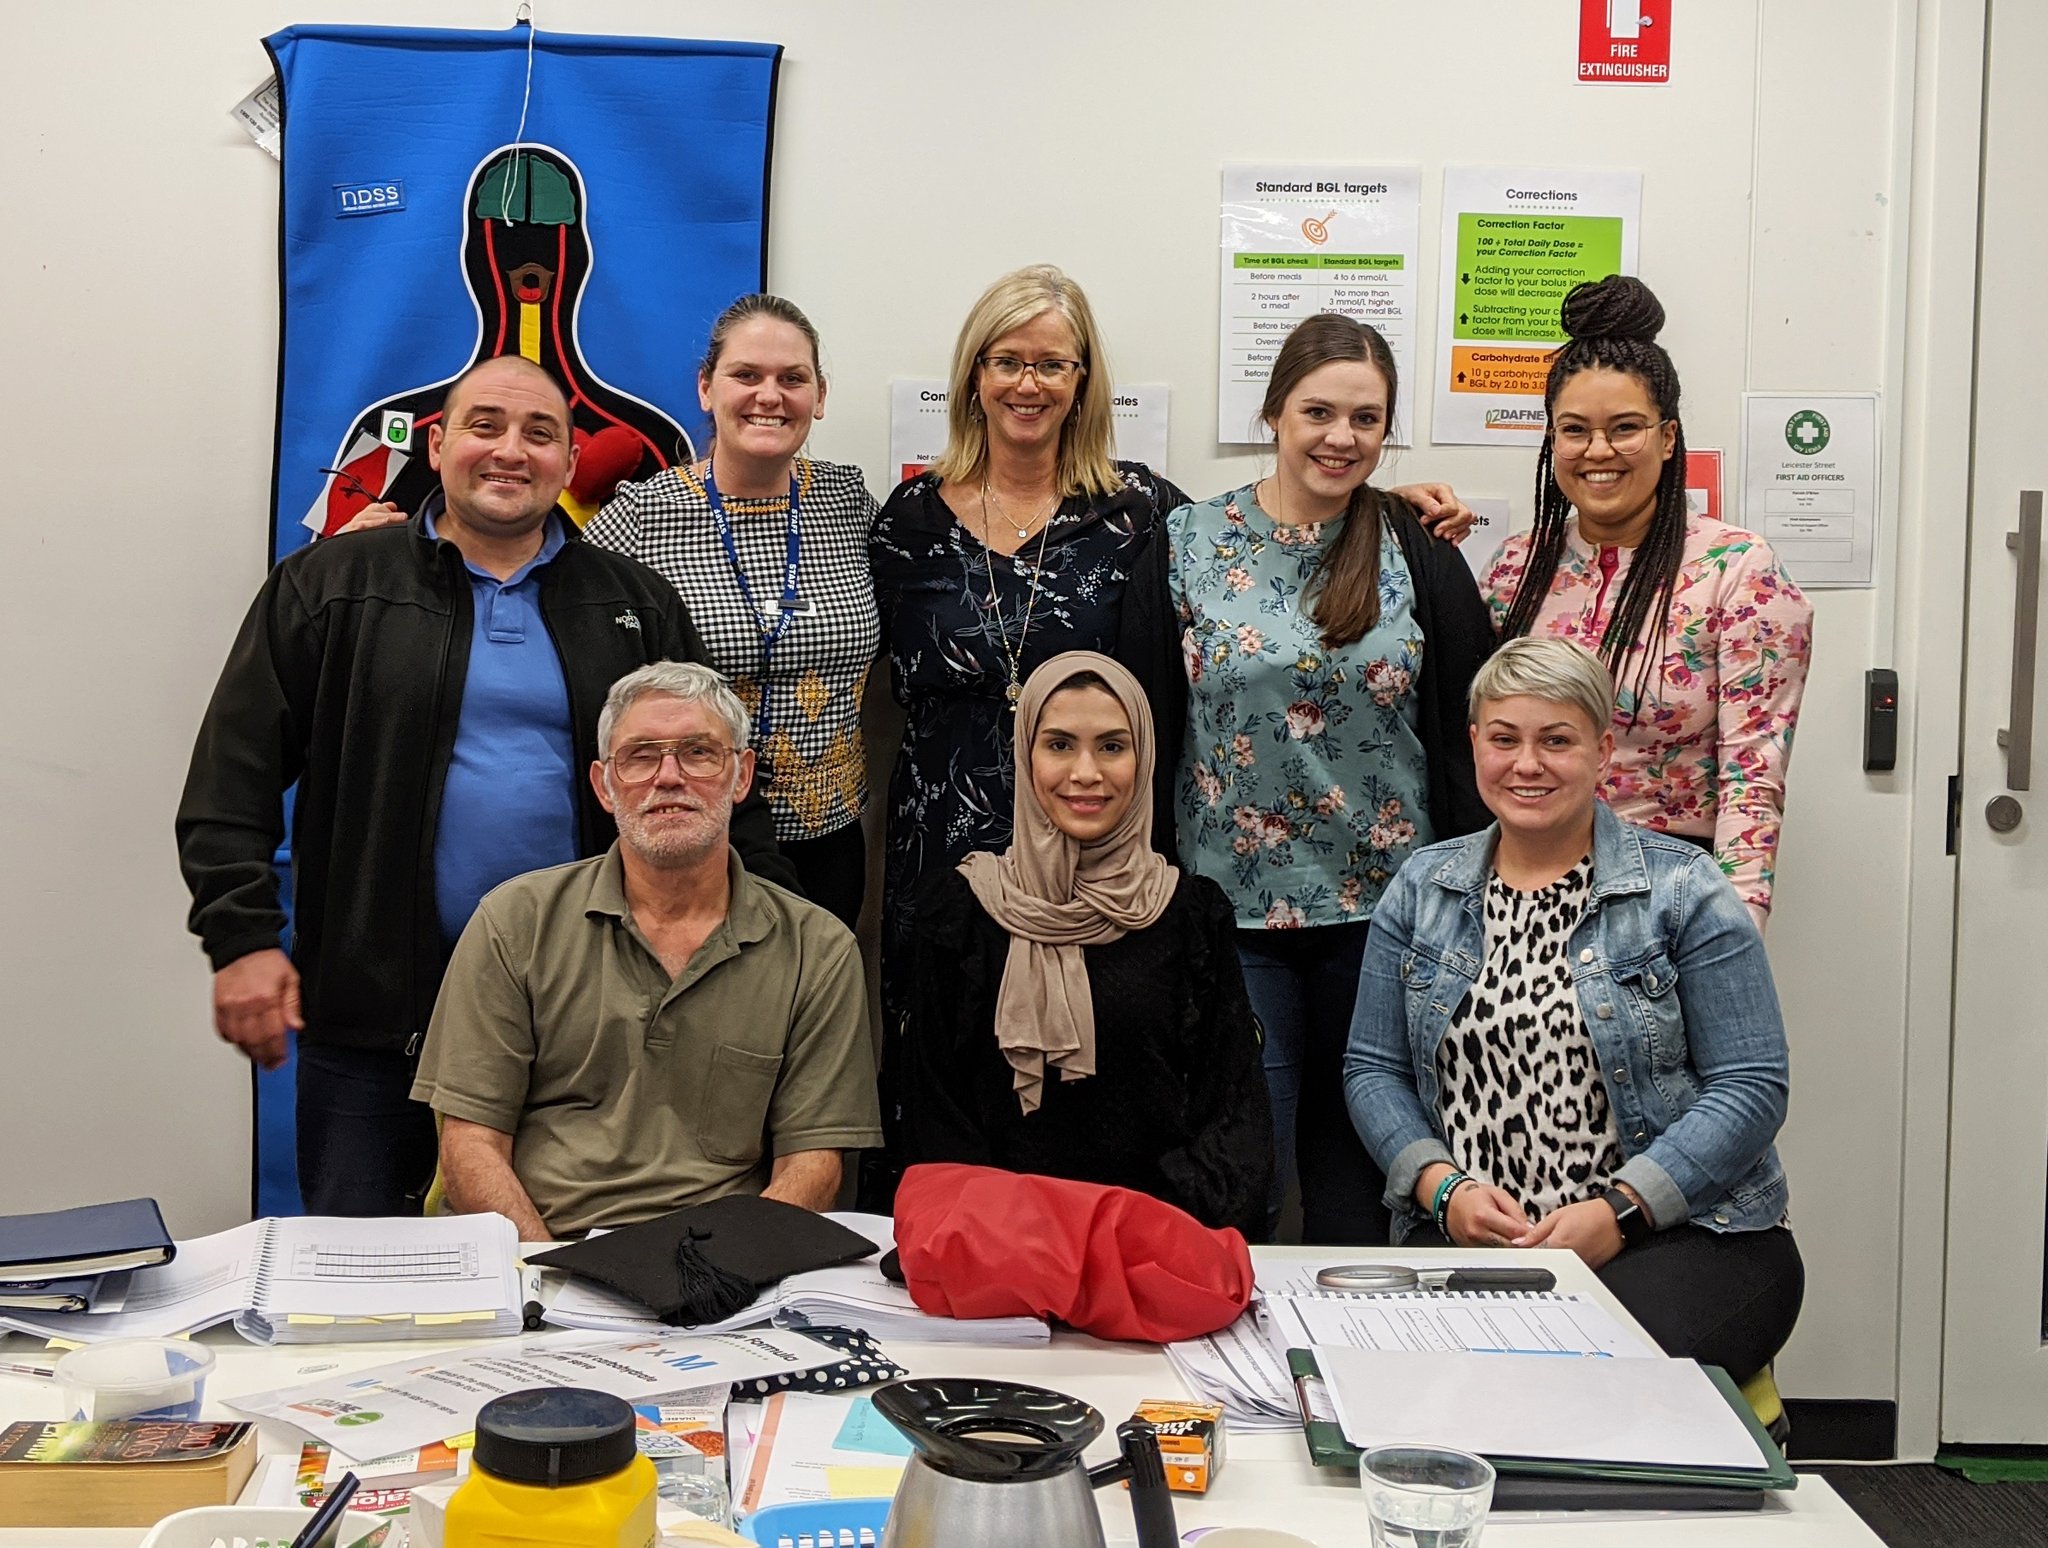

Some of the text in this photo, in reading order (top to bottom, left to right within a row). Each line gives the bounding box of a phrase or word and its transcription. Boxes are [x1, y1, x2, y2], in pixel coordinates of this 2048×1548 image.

[1610, 44, 1638, 57] FIRE
[1580, 62, 1667, 77] EXTINGUISHER
[1256, 182, 1387, 195] Standard BGL targets
[1506, 188, 1578, 201] Corrections
[1477, 219, 1565, 230] Correction Factor
[1478, 238, 1493, 246] 100
[1503, 238, 1526, 247] Total
[1528, 239, 1551, 249] Daily
[1553, 240, 1575, 248] Dose
[1476, 248, 1577, 258] your Correction Factor
[1374, 259, 1399, 267] targets
[1475, 265, 1585, 277] Adding your correction
[1474, 276, 1502, 285] factor
[1505, 277, 1514, 285] to
[1517, 279, 1541, 288] your
[1541, 278, 1567, 287] bolus
[1282, 293, 1300, 301] after
[1474, 287, 1563, 297] dose will decrease
[1368, 299, 1394, 307] higher
[1340, 307, 1364, 315] before
[1473, 305, 1527, 316] Subtracting
[1472, 316, 1500, 324] factor
[1503, 317, 1524, 325] from
[1527, 319, 1548, 327] your
[1472, 327, 1495, 335] dose
[1498, 327, 1512, 336] will
[1515, 328, 1556, 337] increase
[1471, 353, 1540, 364] Carbohydrate
[1471, 368, 1548, 380] 10 g carbohydra
[1469, 379, 1545, 389] BGL by 2.0 to 3.0
[714, 508, 727, 535] STAFF
[788, 564, 797, 590] STAFF
[777, 613, 791, 639] STAFF
[743, 1337, 799, 1362] Formula
[662, 1355, 719, 1371] M
[592, 1356, 658, 1382] carbohydrate
